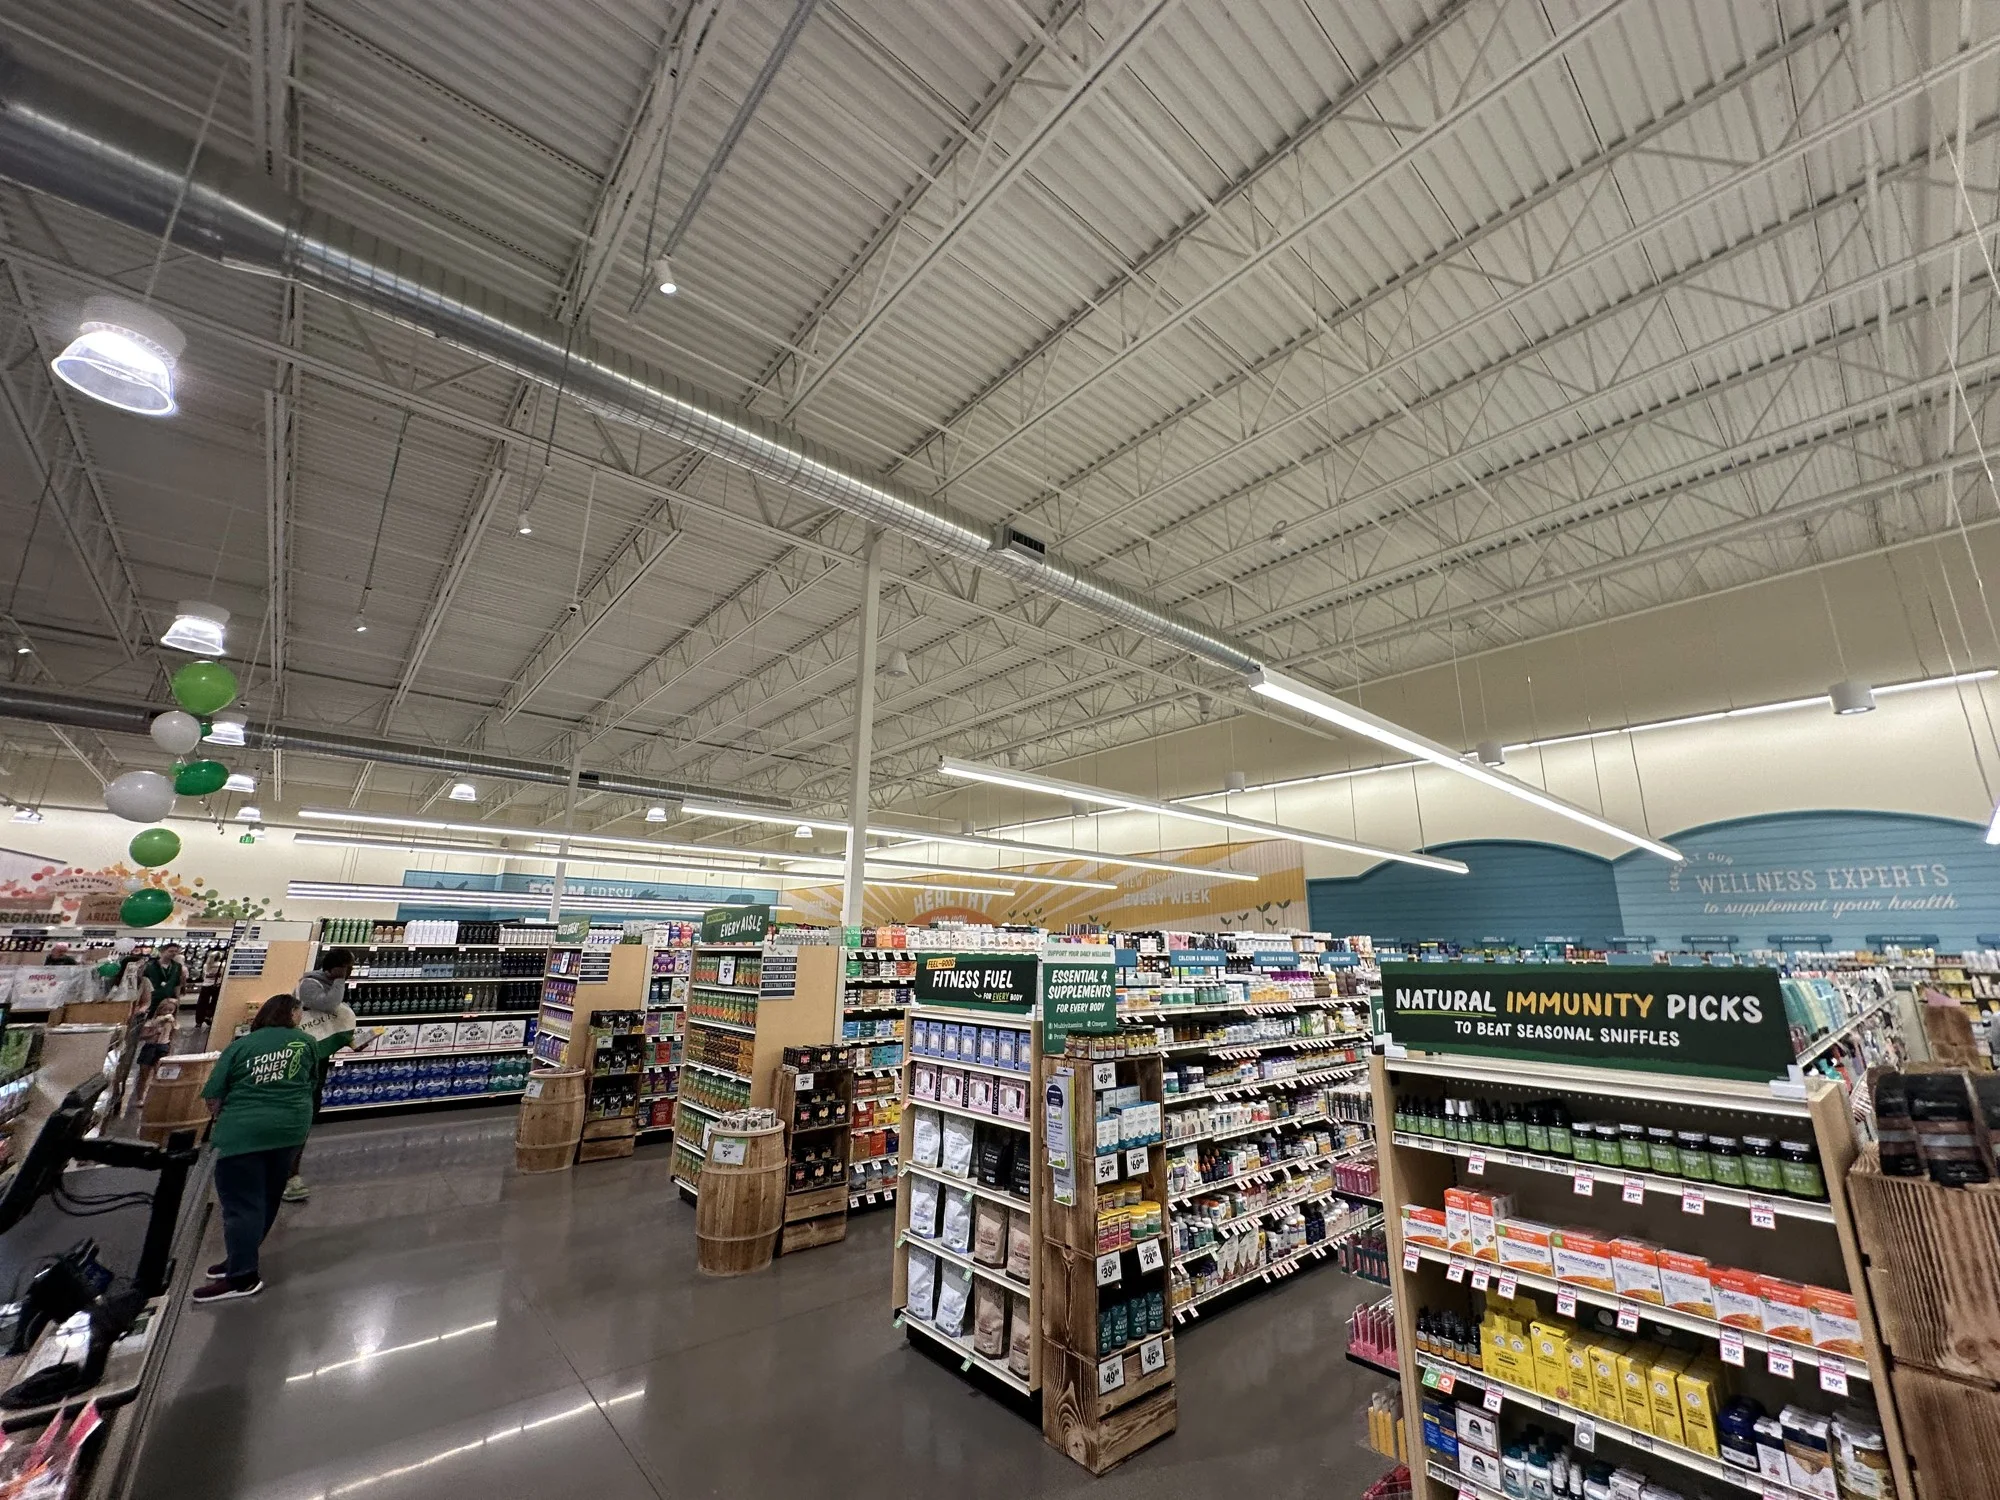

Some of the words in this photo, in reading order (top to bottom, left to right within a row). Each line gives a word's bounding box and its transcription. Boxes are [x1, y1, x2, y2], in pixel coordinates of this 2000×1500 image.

[1708, 853, 1734, 866] OUR
[1695, 869, 1817, 895] WELLNESS
[1826, 864, 1949, 891] EXPERTS
[528, 882, 586, 896] FAM
[1123, 892, 1166, 906] EVERY
[1170, 889, 1211, 904] WEEK
[1704, 900, 1718, 914] to
[1725, 898, 1828, 918] supplement
[1832, 900, 1882, 919] your
[1889, 893, 1957, 911] health
[0, 912, 62, 924] RGANIC
[86, 912, 119, 922] ARIZO
[720, 921, 741, 938] EVERY
[740, 914, 762, 932] AISLE
[927, 959, 955, 968] FEEL-GOOD
[932, 970, 980, 988] FITNESS
[983, 970, 1013, 988] FUEL
[1051, 970, 1099, 983] ESSENTIAL
[1101, 970, 1108, 983] 4
[983, 992, 992, 1000] FOR
[992, 992, 1010, 1001] EVERY
[1047, 985, 1112, 999] SUPPLEMENTS
[1056, 1004, 1069, 1013] FOR
[1069, 1003, 1089, 1013] EVERY
[1089, 1002, 1106, 1012] BODY
[1395, 989, 1497, 1011] NATURAL
[1505, 991, 1654, 1018] IMMUNITY
[1666, 994, 1764, 1024] PICKS
[1454, 1020, 1471, 1035] TO
[1477, 1022, 1511, 1037] BEAT
[1516, 1023, 1595, 1042] SEASONAL
[1600, 1027, 1680, 1047] SNIFFLES
[246, 1059, 250, 1069] I
[254, 1049, 293, 1065] FOUND
[251, 1060, 288, 1076] INNER
[255, 1070, 285, 1085] PEAS
